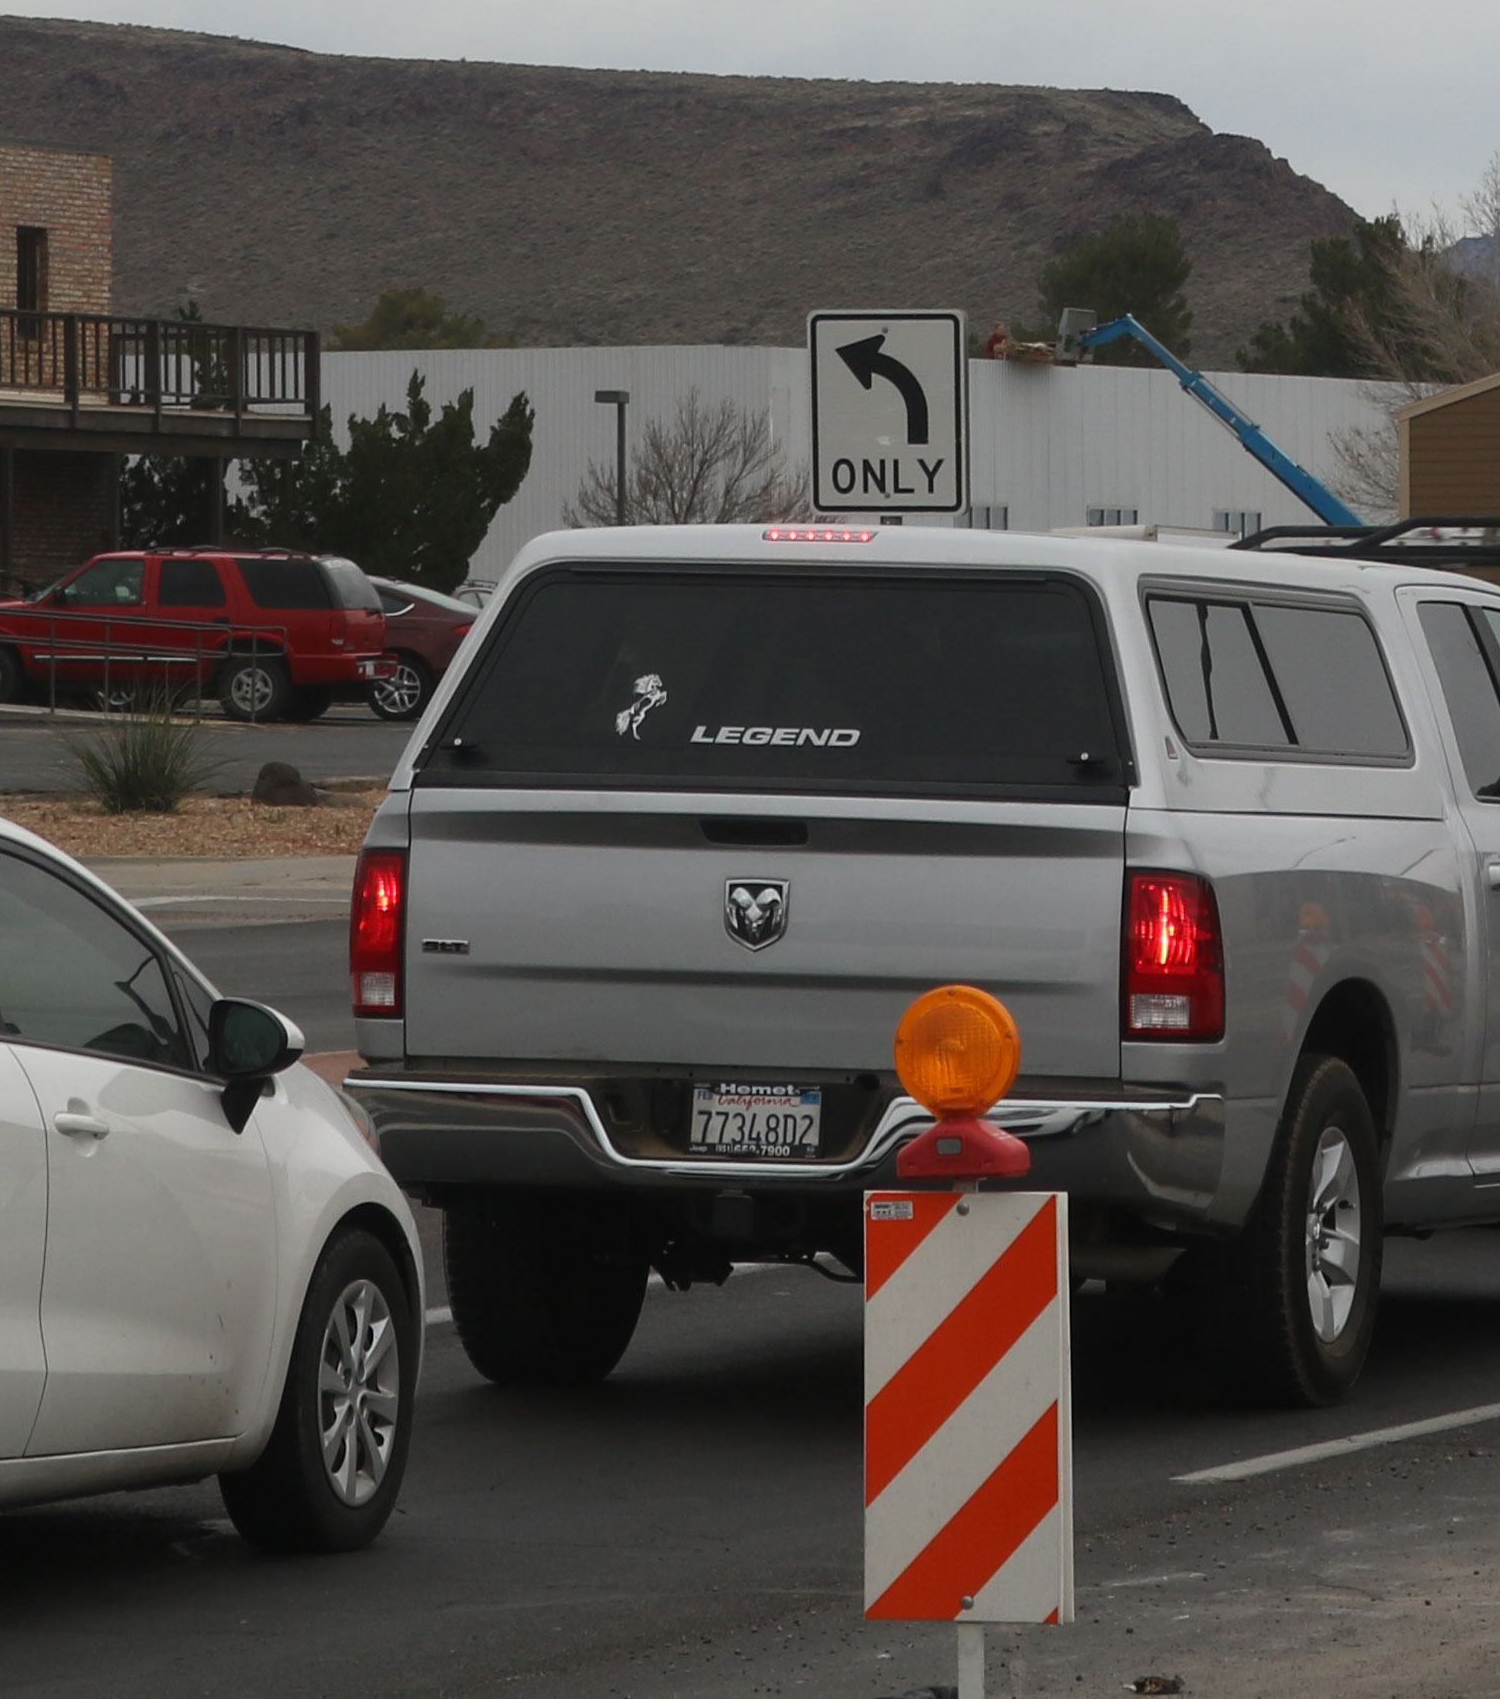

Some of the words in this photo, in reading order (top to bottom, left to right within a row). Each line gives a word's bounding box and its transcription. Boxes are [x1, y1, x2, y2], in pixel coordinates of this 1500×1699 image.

[832, 458, 944, 495] ONLY
[690, 725, 861, 747] LEGEND
[720, 1083, 798, 1096] Hemet
[718, 1094, 800, 1111] California
[697, 1110, 815, 1147] 77348D2
